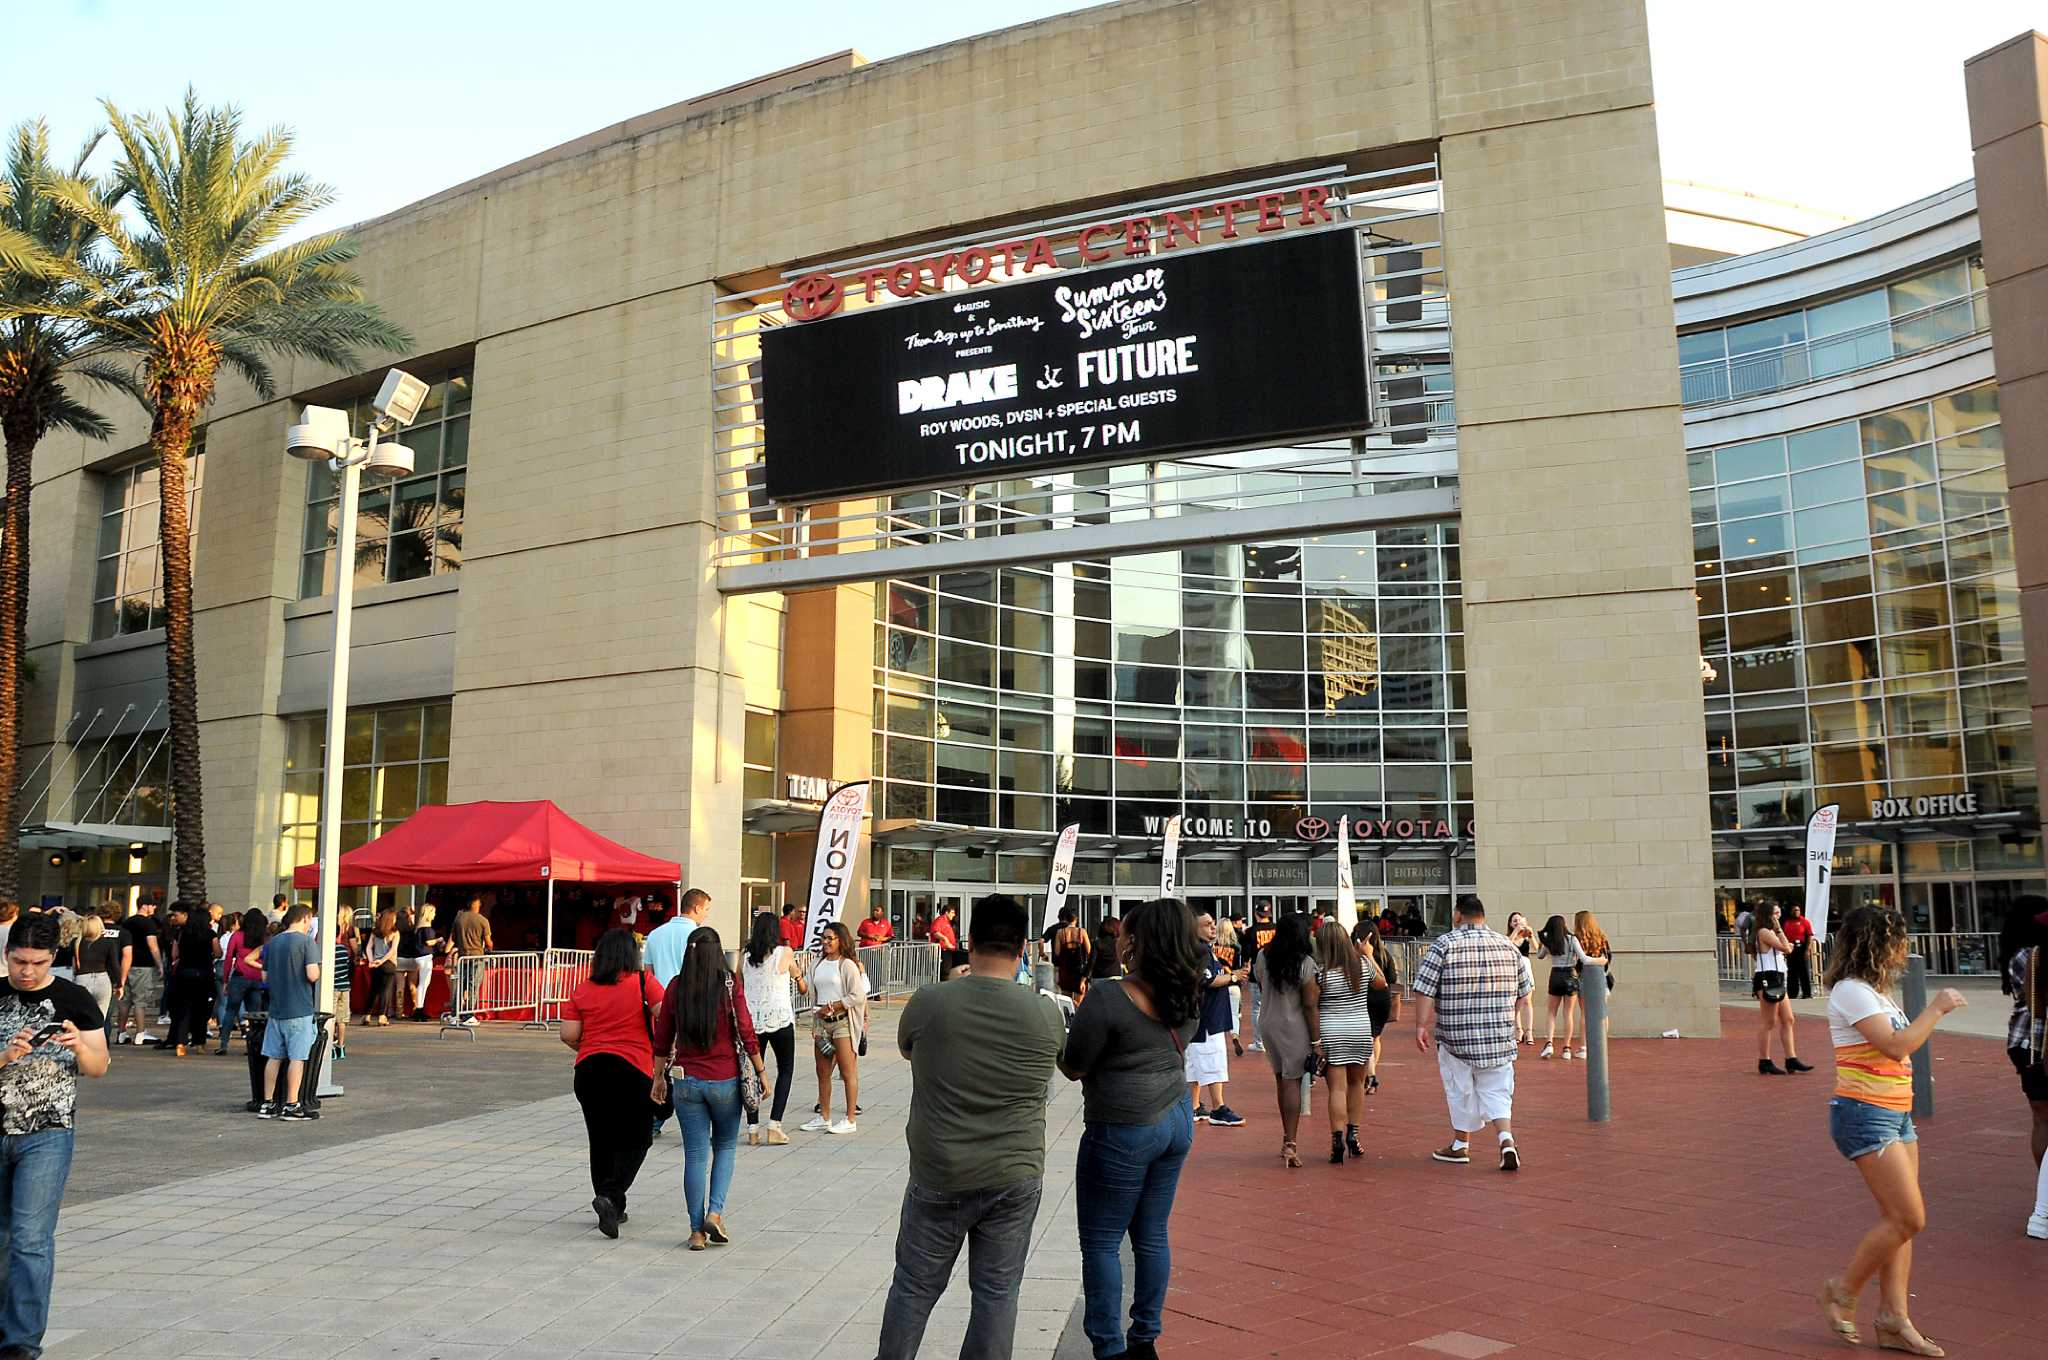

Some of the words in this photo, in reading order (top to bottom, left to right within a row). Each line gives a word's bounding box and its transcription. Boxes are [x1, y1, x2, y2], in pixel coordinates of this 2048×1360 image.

[857, 236, 1058, 302] TOYOTA
[1078, 185, 1332, 262] CENTER
[1055, 268, 1165, 323] Summer
[1077, 290, 1167, 339] Sixteen
[1121, 317, 1157, 340] Tour
[956, 345, 993, 358] PRESENTS
[898, 364, 1018, 414] DRAKE
[1036, 364, 1064, 390] &
[1078, 335, 1199, 388] FUTURE
[920, 422, 948, 437] ROY
[950, 414, 1004, 433] WOODS,
[1006, 409, 1043, 425] DVSN
[1045, 409, 1056, 420] +
[1057, 398, 1116, 418] SPECIAL
[1118, 389, 1177, 408] GUESTS
[955, 430, 1076, 464] TONIGHT,
[1080, 426, 1096, 449] 7
[1102, 420, 1140, 446] PM
[788, 775, 828, 802] TEAM
[1872, 799, 1911, 819] BOX
[1916, 794, 1978, 816] OFFICE
[1144, 816, 1233, 836] WCOME
[1248, 819, 1271, 837] TO
[1336, 819, 1452, 838] OYOTA
[1252, 864, 1264, 878] LA
[1267, 866, 1304, 879] BRANCH
[1394, 866, 1443, 879] ENTRANCE
